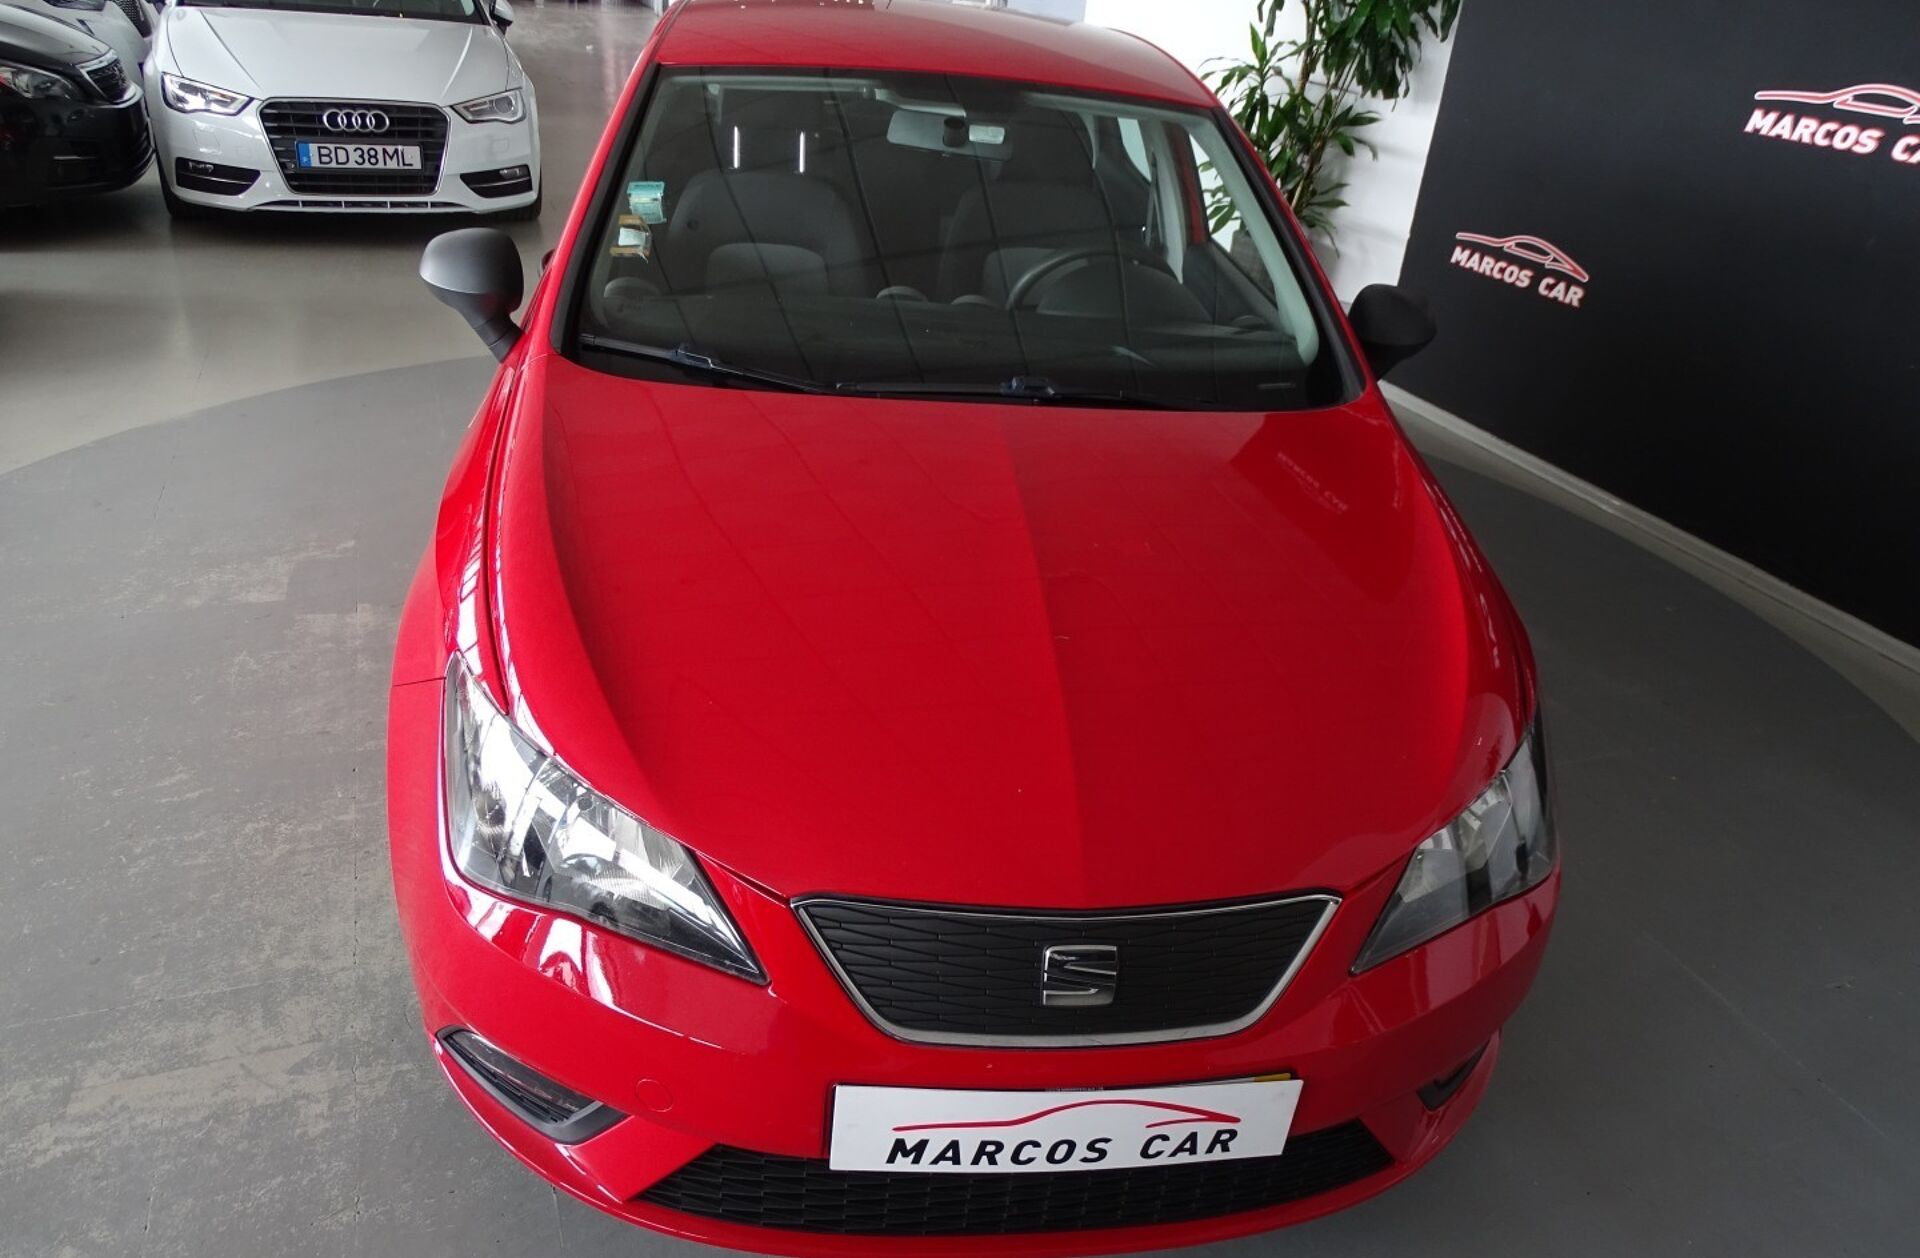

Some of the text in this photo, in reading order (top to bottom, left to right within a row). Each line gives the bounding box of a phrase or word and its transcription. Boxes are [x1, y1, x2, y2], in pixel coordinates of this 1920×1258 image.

[1744, 109, 1885, 154] MARCOS
[1450, 246, 1585, 308] MARCOS CAR
[886, 1128, 1239, 1166] MARCOS CAR
